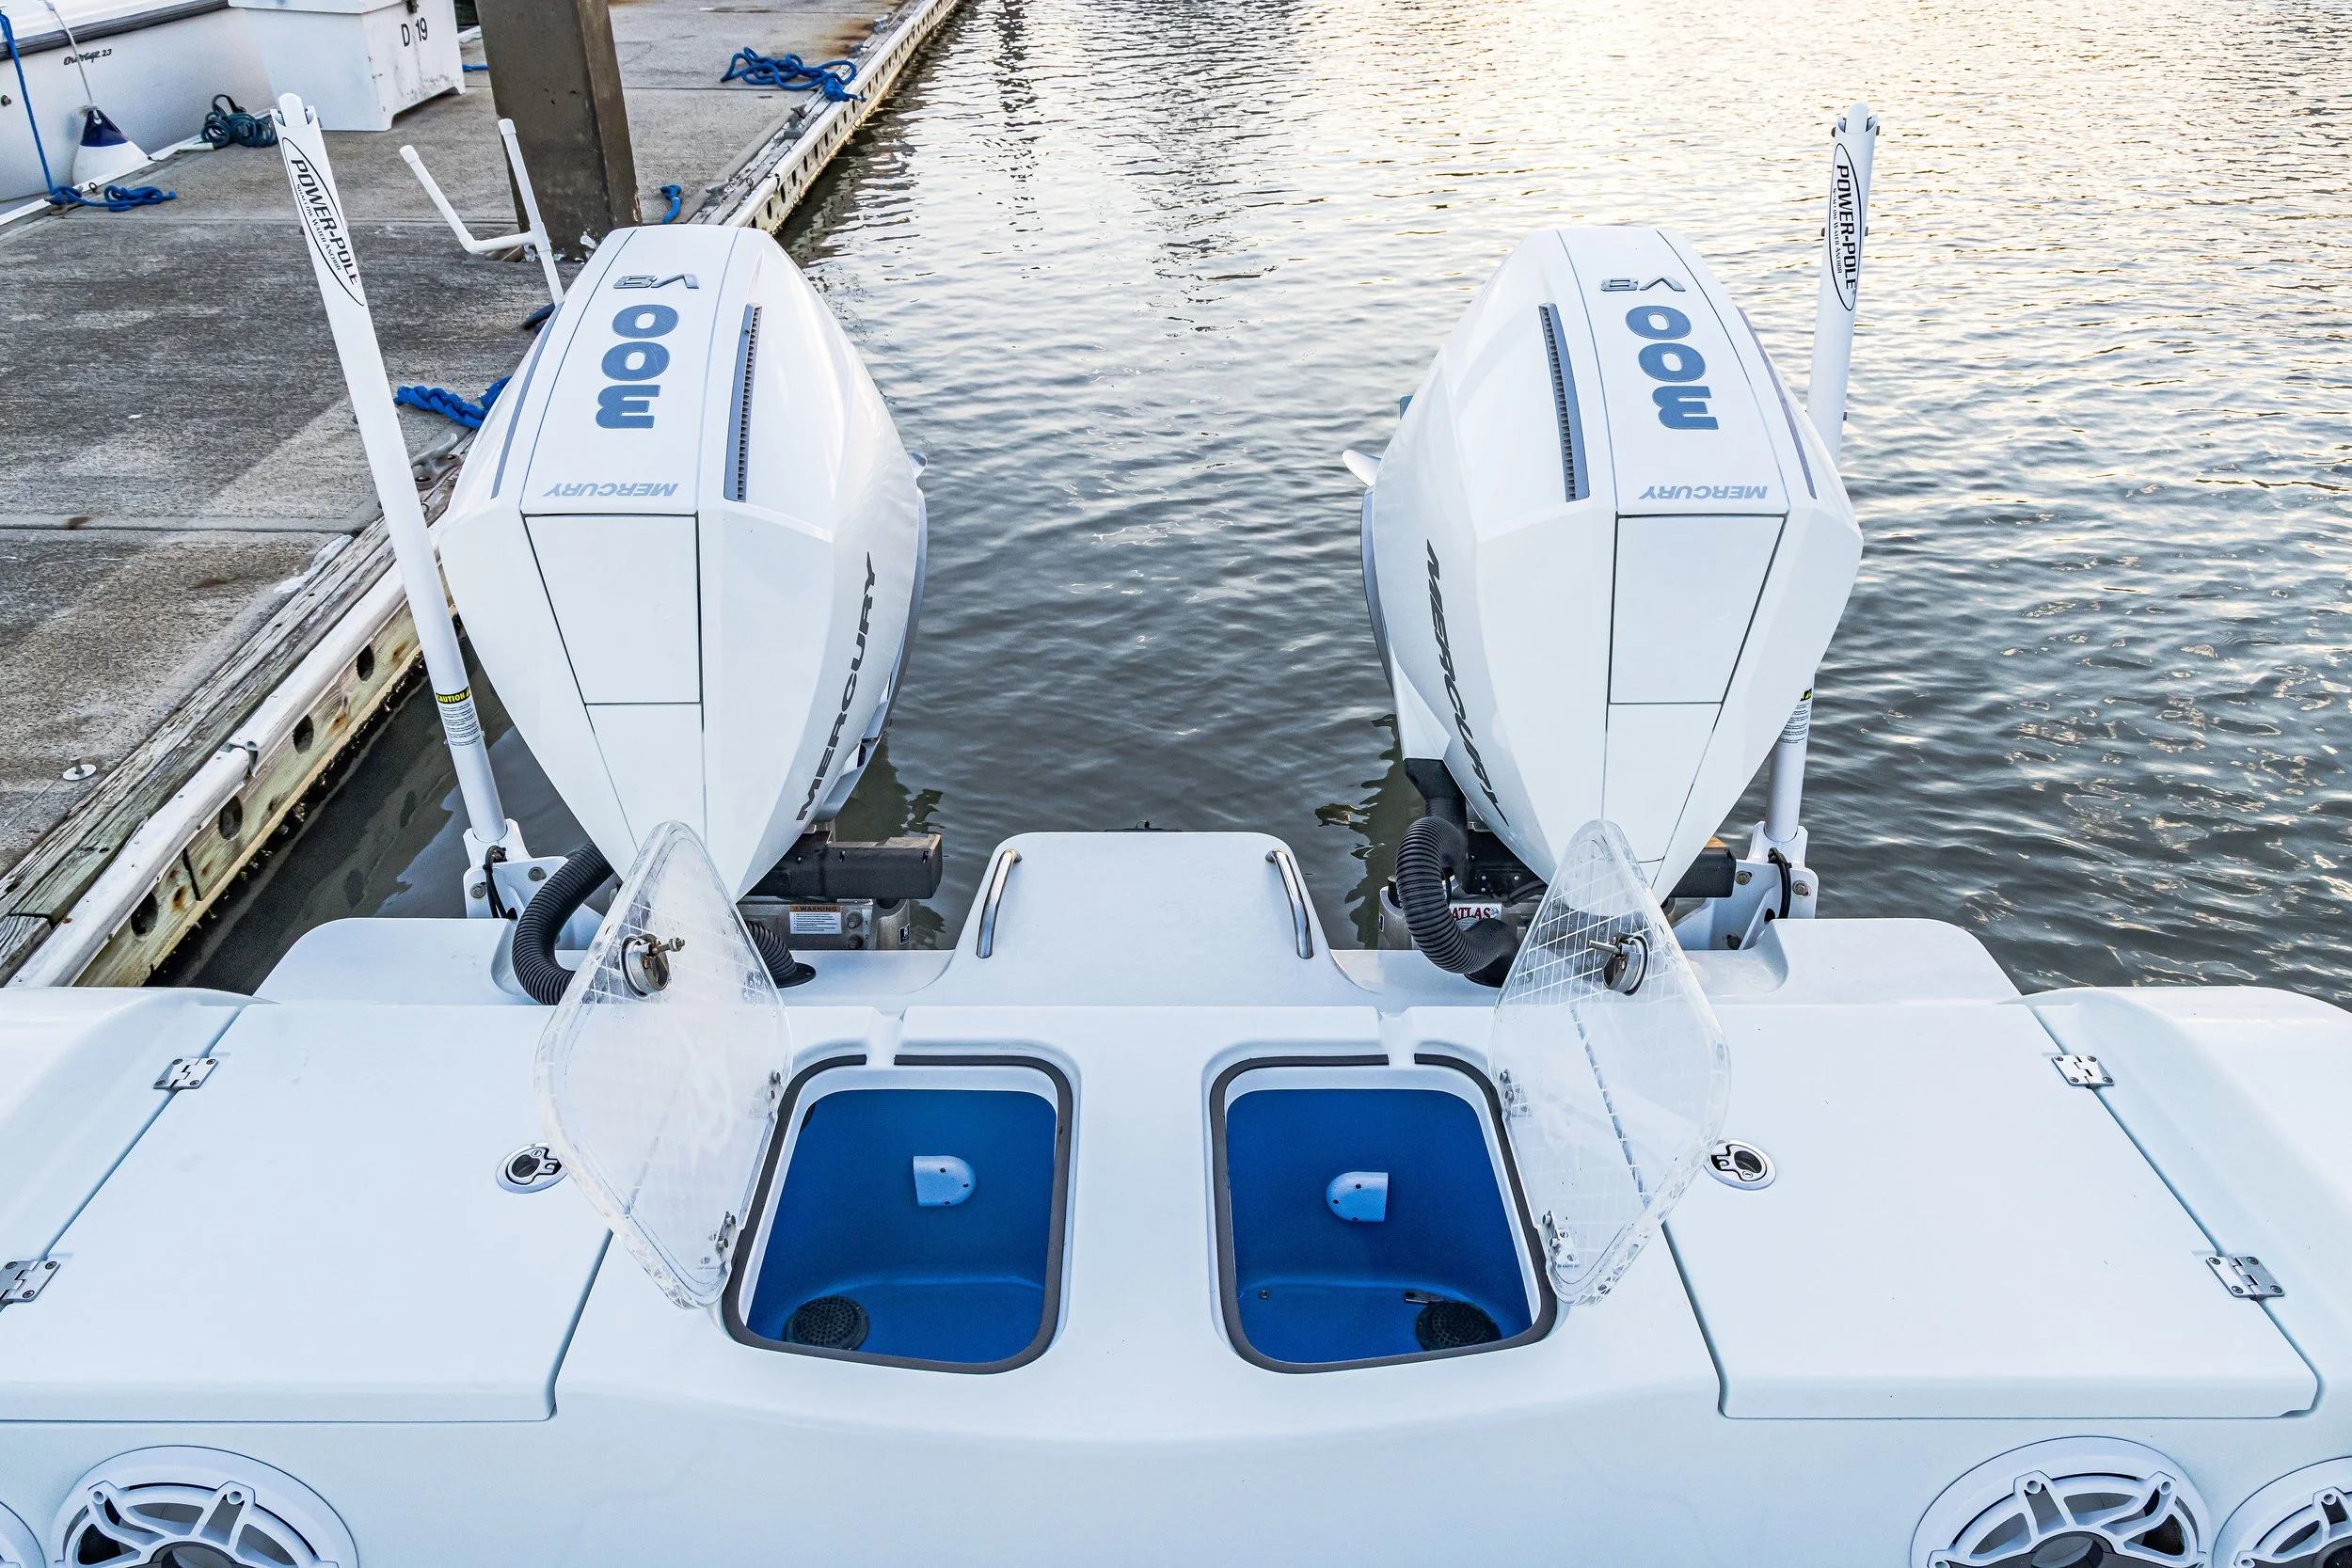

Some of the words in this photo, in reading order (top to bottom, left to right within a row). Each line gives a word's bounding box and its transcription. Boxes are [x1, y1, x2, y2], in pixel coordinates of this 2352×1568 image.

[401, 24, 410, 47] D
[415, 17, 428, 41] 19
[102, 48, 112, 56] 23
[291, 159, 358, 285] POWER-POLE
[1836, 165, 1857, 290] POWER-POLE
[613, 274, 700, 289] V8
[1600, 277, 1687, 293] V8
[596, 304, 679, 430] 300
[1624, 305, 1720, 431] 300
[544, 482, 679, 498] MERCURY
[1637, 484, 1769, 500] MERCURY
[796, 550, 877, 821] MERCURY
[1426, 538, 1509, 827] MERCURY
[1452, 907, 1491, 921] ATLAS
